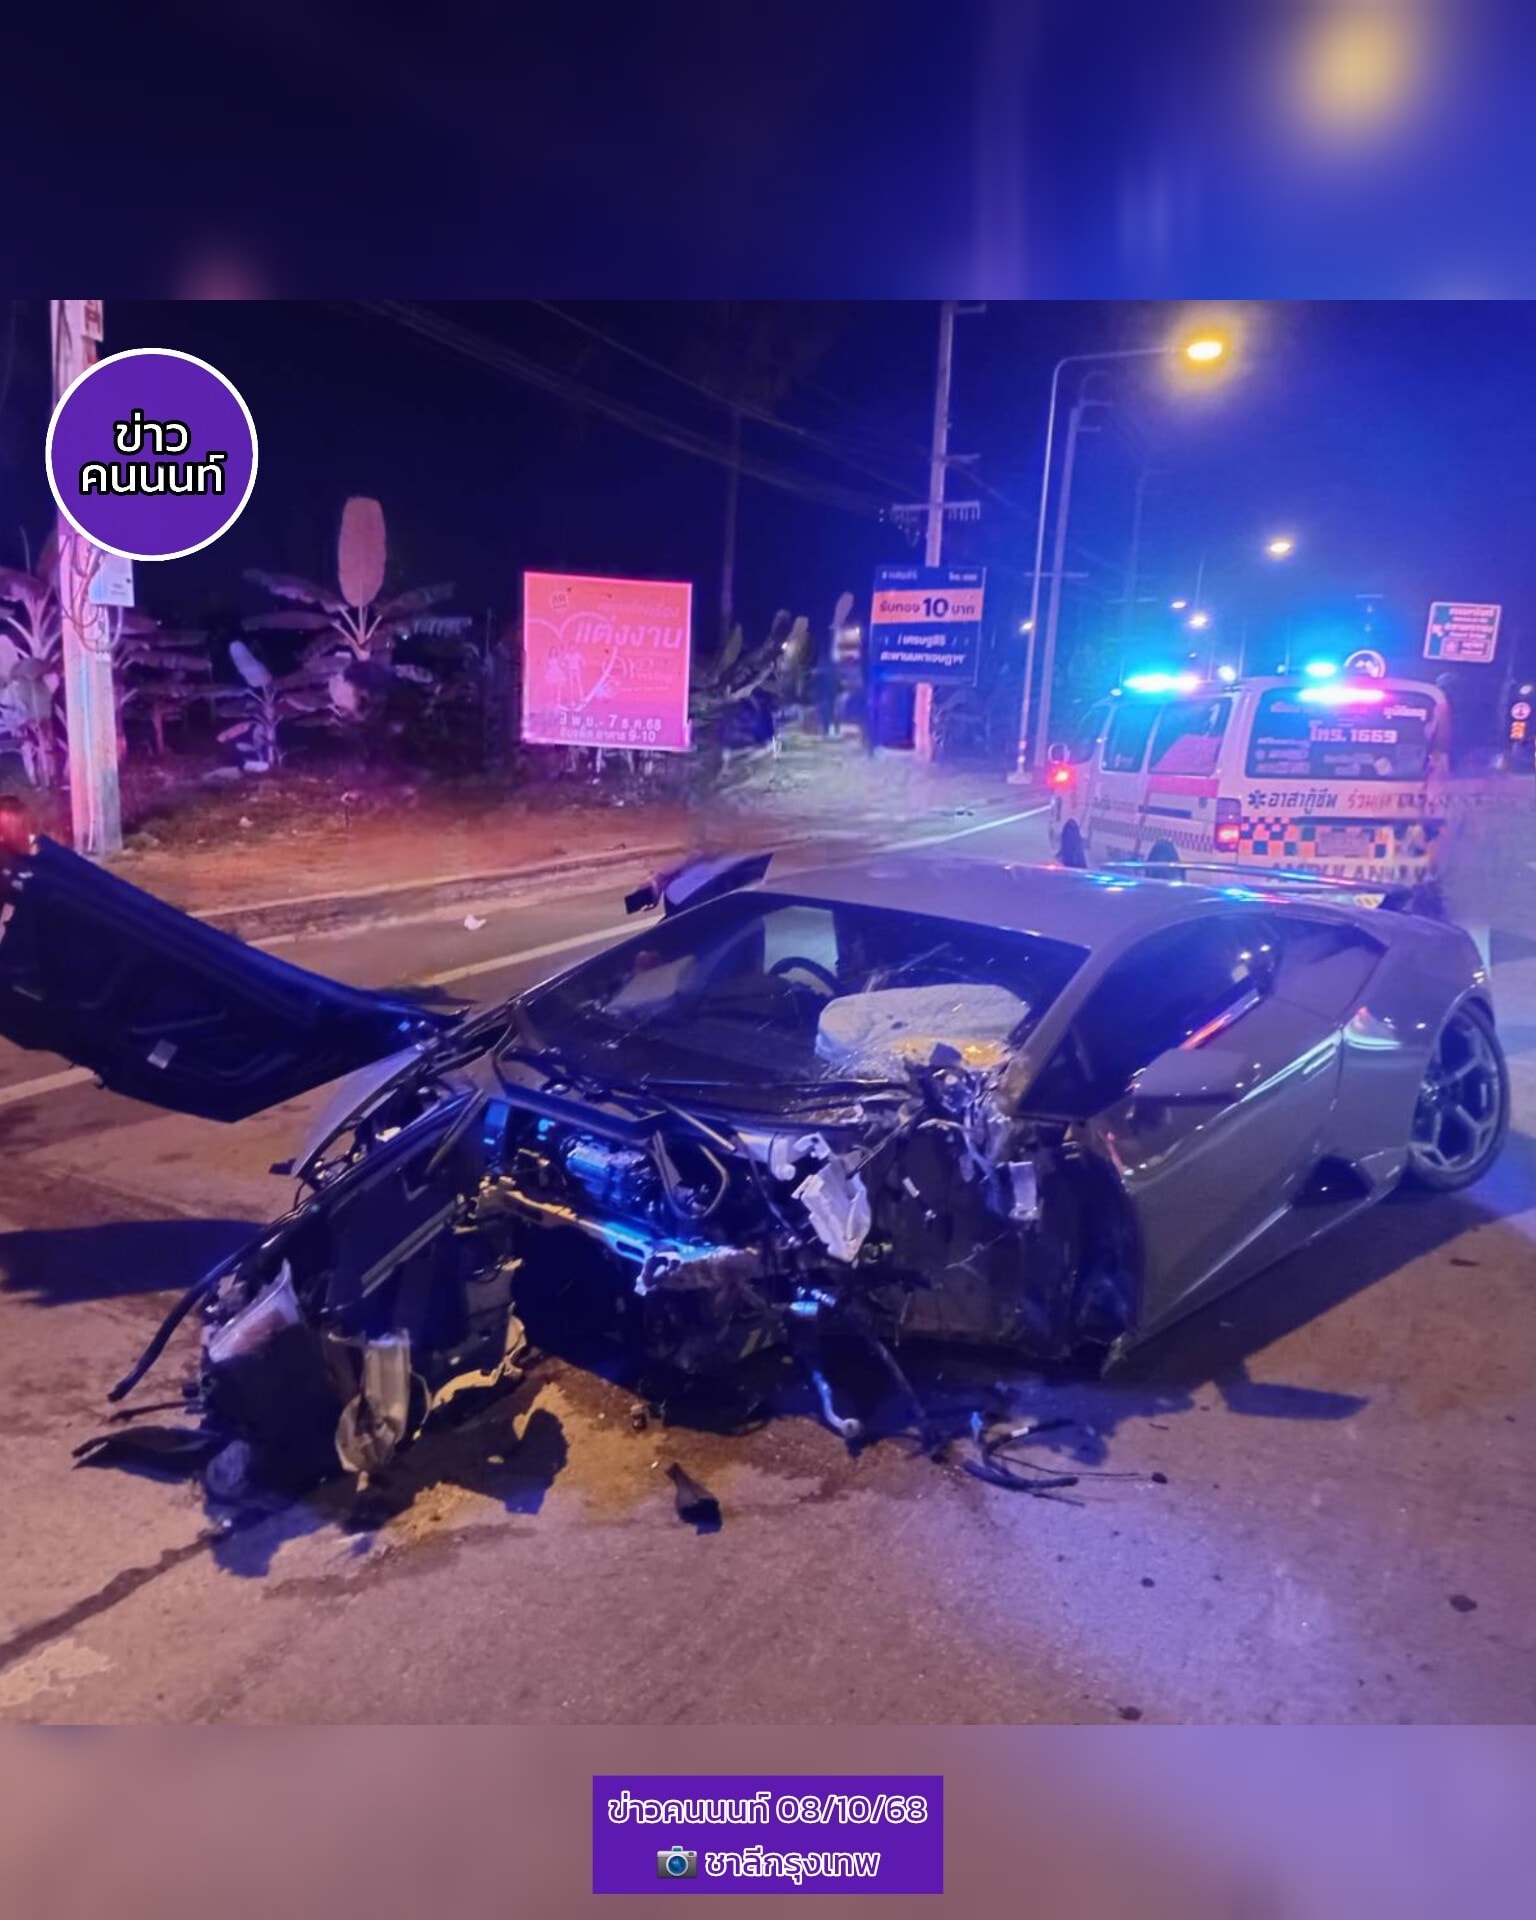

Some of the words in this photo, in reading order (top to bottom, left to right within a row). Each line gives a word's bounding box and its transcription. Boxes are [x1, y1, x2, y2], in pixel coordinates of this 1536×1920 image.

[923, 597, 949, 618] 10
[574, 616, 684, 650] แต่งงาน
[608, 714, 618, 728] 7
[628, 730, 657, 743] 9-10
[1267, 788, 1339, 814] อาสากู้ชีพ
